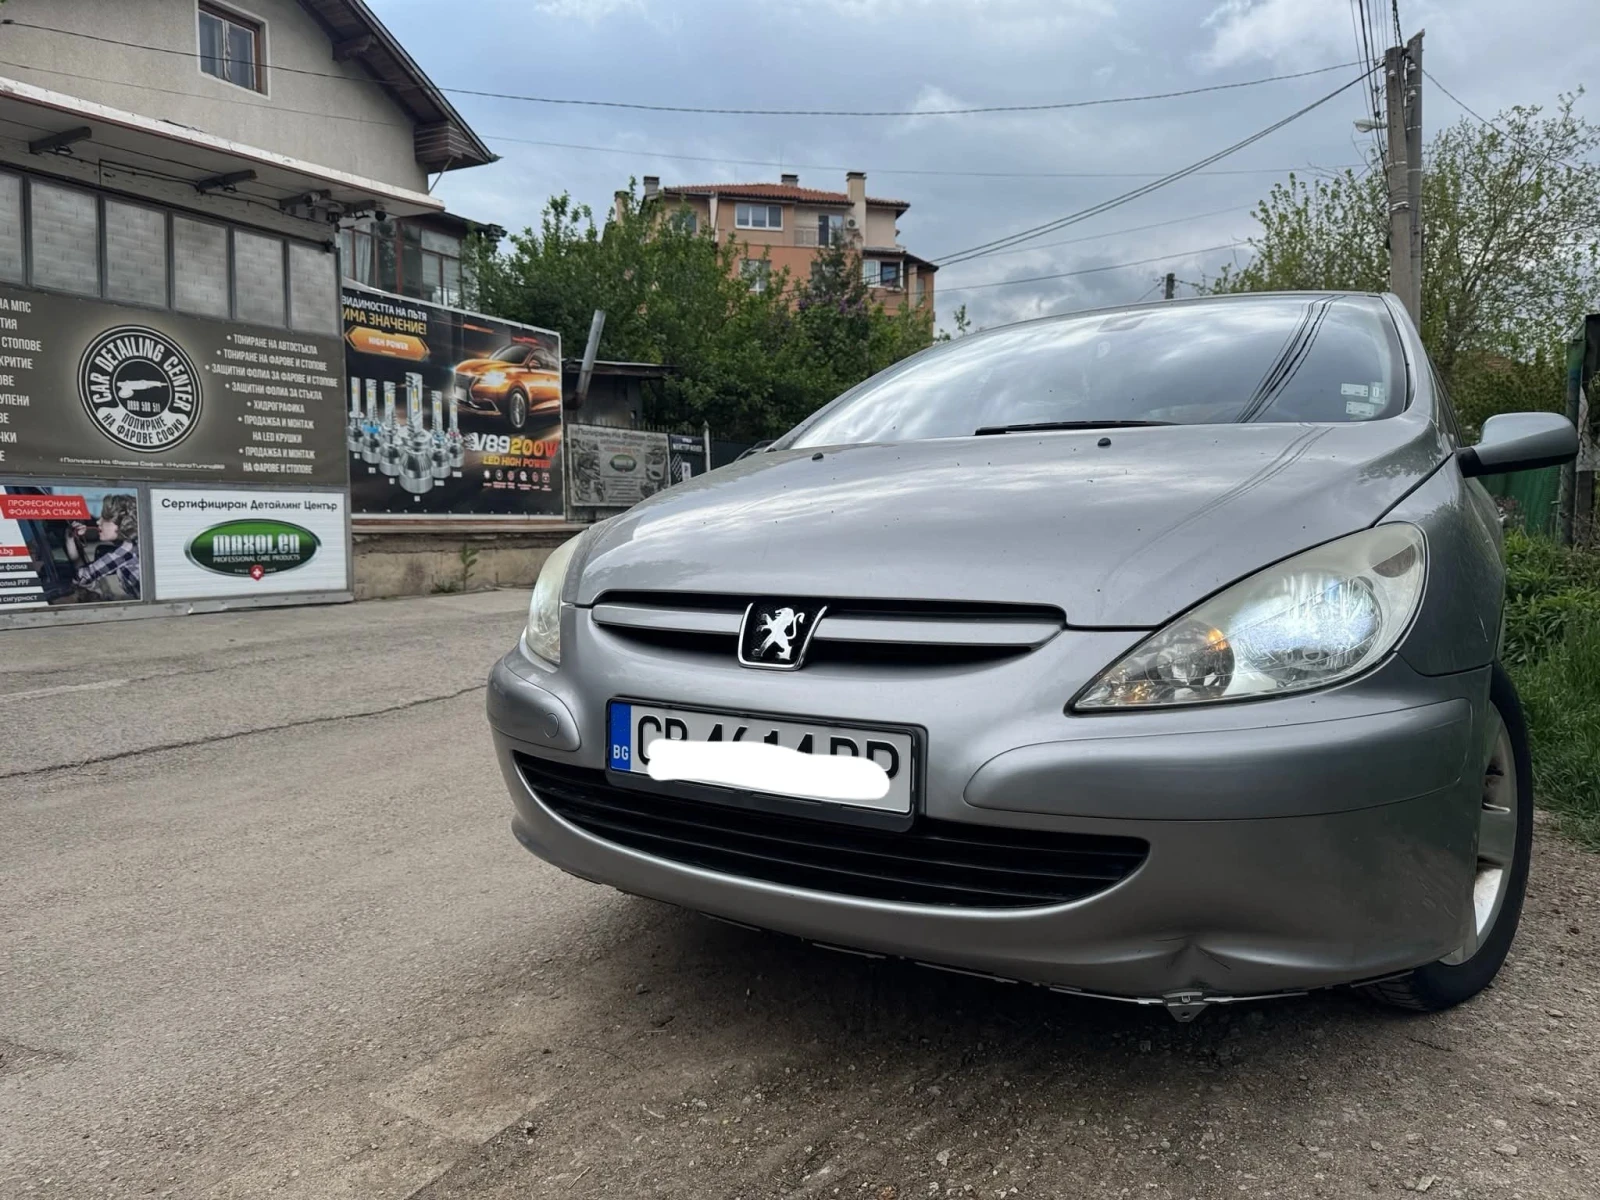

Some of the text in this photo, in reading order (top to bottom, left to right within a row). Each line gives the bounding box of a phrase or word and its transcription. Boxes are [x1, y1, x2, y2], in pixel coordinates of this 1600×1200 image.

[11, 299, 31, 313] МПС
[396, 307, 406, 316] НА
[408, 310, 427, 321] ПЪТЯ
[342, 308, 427, 335] ИМА ЗНАЧЕНИЕ!
[1, 336, 42, 352] СТОПОВЕ
[234, 334, 267, 348] ТОНИРАНЕ
[268, 339, 277, 349] НА
[224, 348, 258, 362] ТОНИРАНЕ
[259, 354, 268, 363] НА
[269, 354, 294, 366] ФАРОВЕ
[90, 337, 192, 412] CAR DETAILING CENTER
[212, 363, 246, 376] ЗАЩИТНИ
[272, 370, 280, 380] ЗА
[232, 382, 264, 394] ЗАЩИТНИ
[290, 388, 298, 397] ЗА
[244, 415, 280, 426] ПРОДАЖБА
[102, 413, 185, 444] НА ФАРОВЕ СОФИЯ
[252, 432, 262, 440] НА
[263, 432, 274, 442] LED
[245, 446, 282, 458] ПРОДАЖБА
[243, 462, 252, 472] НА
[483, 456, 500, 464] LED
[502, 456, 522, 466] HIGH
[8, 500, 80, 508] ПРОФЕСИОНАЛНИ
[162, 498, 338, 512] Сертифициран Детайлинг Център
[212, 555, 255, 564] PROFESSIONAL
[613, 745, 629, 760] BG
